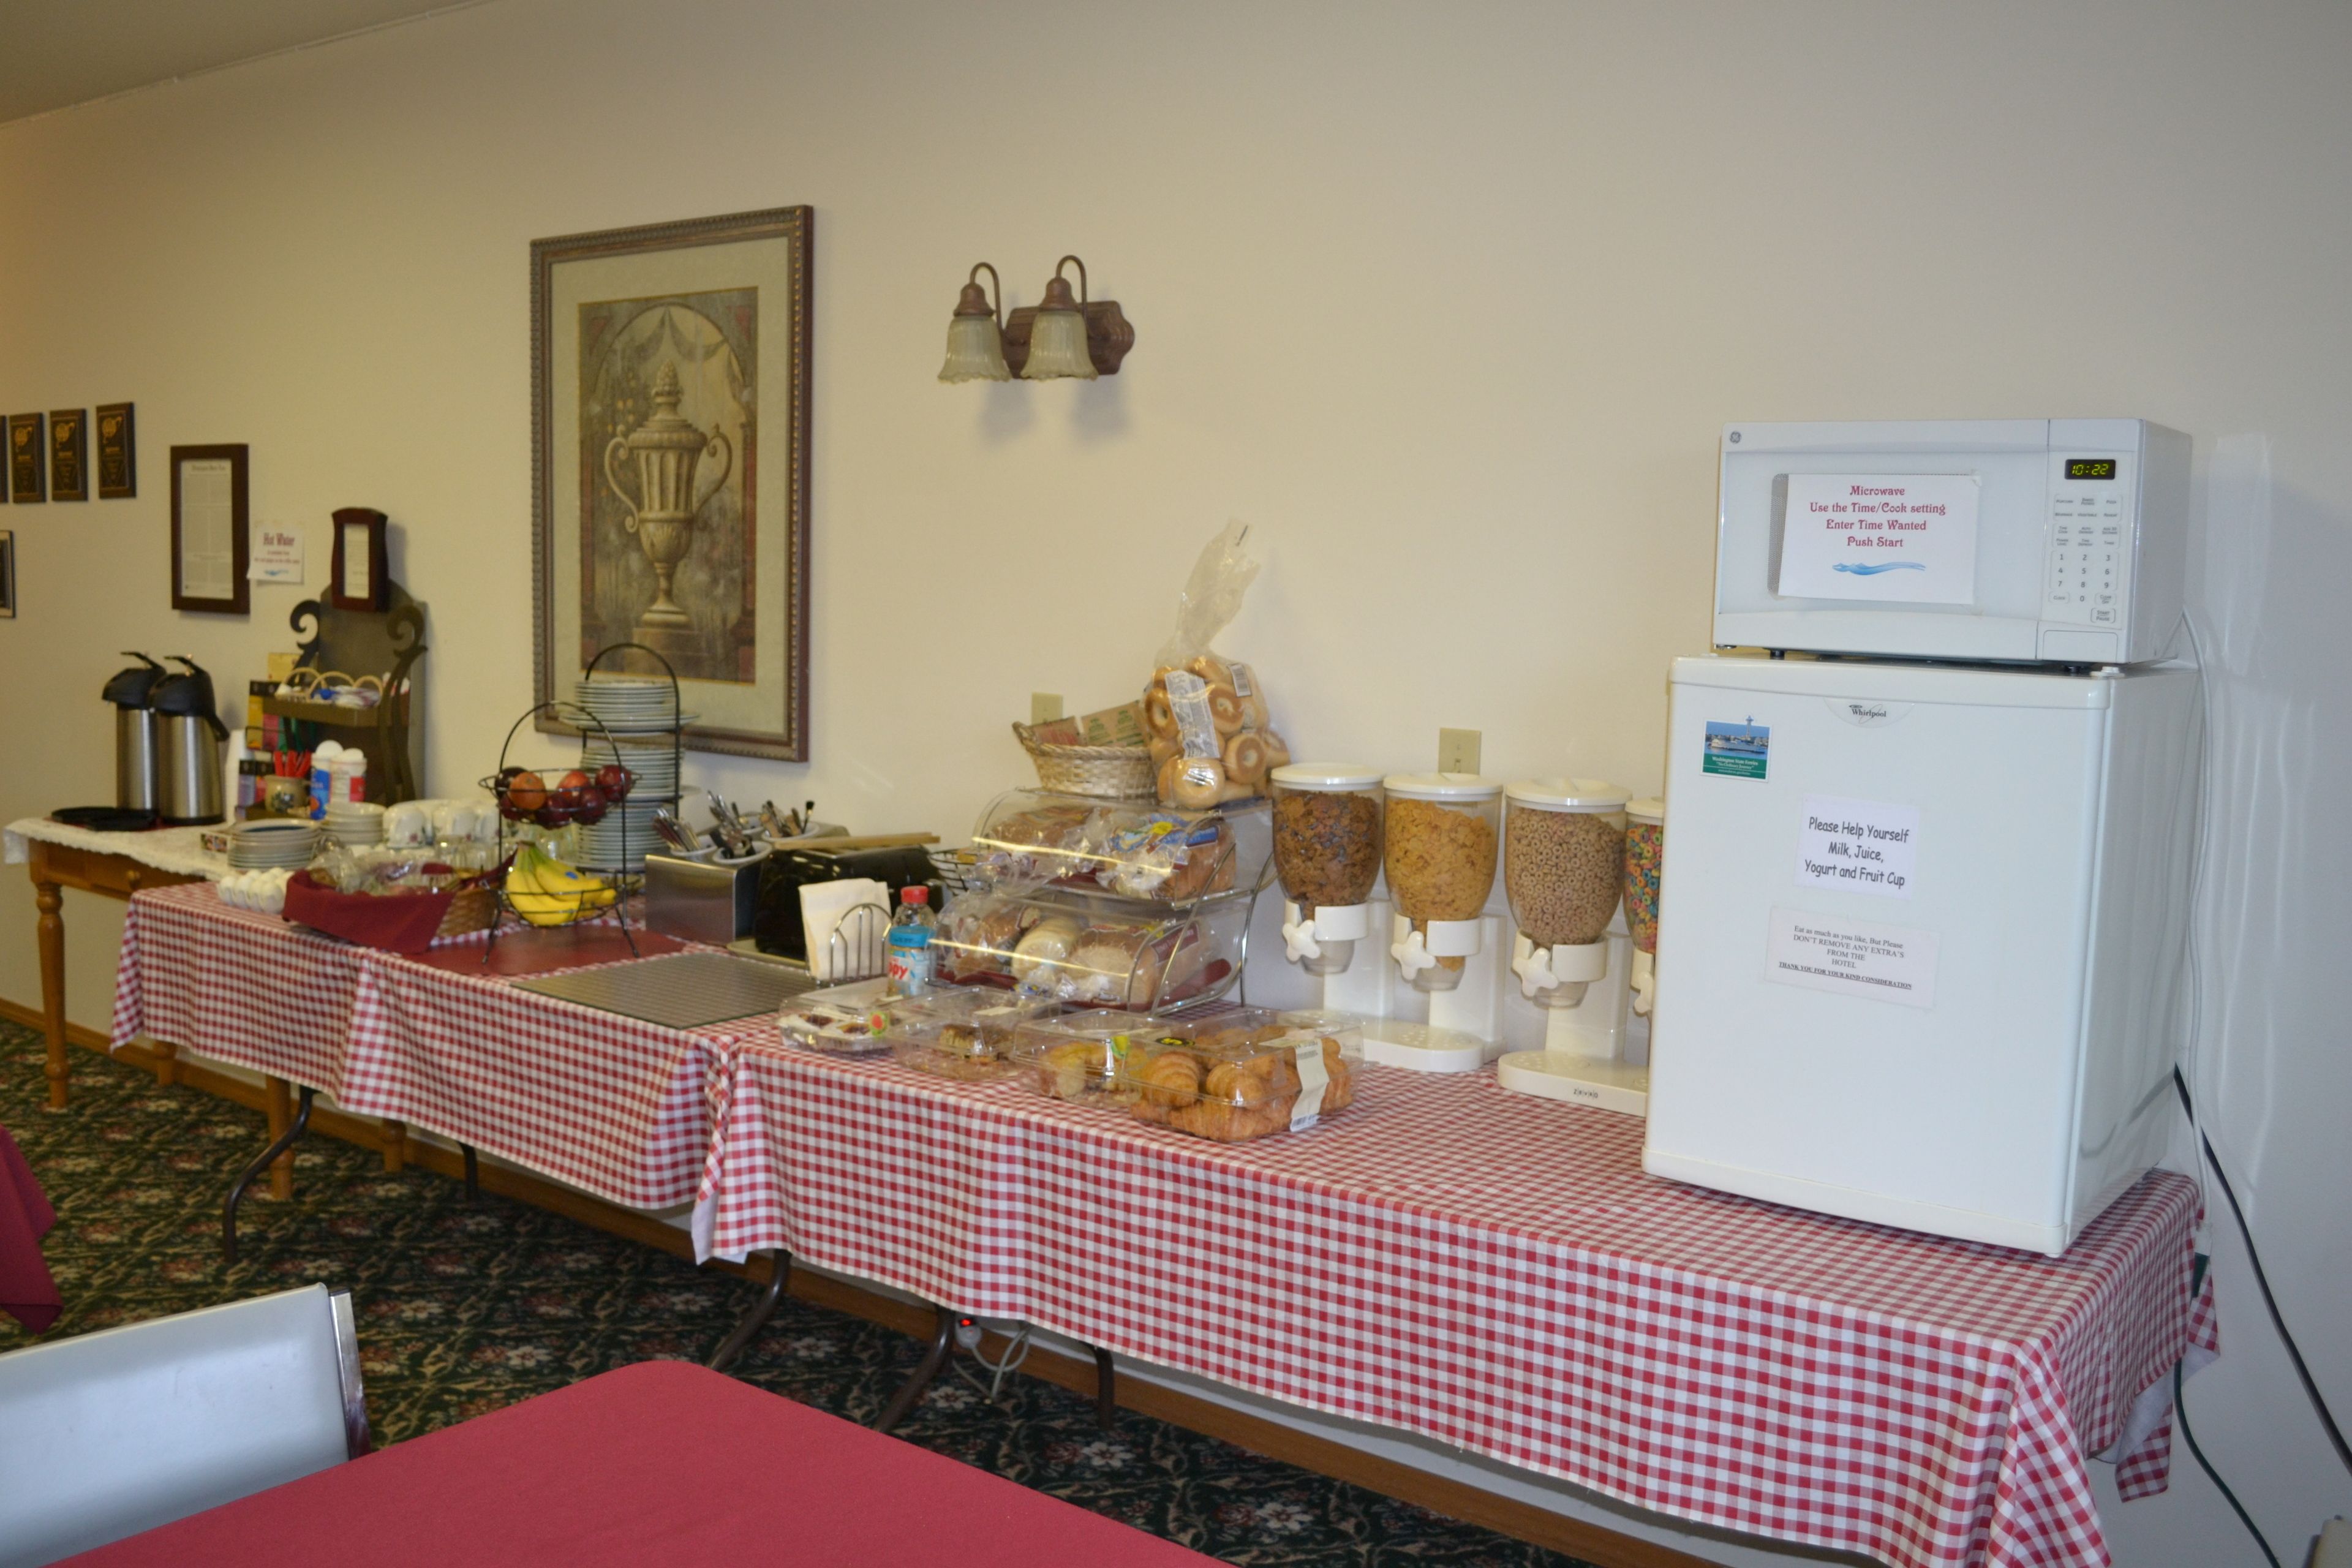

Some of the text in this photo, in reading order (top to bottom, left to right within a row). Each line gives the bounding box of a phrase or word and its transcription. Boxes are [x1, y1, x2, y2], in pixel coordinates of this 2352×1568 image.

[2071, 464, 2109, 475] 10:22
[1850, 485, 1905, 496] Microwave
[1810, 502, 1946, 516] Use the Time/Cook setting
[1826, 519, 1927, 530] Enter Time Wanted
[1847, 536, 1904, 547] Push Start
[1852, 709, 1887, 718] Whirlpool
[1809, 816, 1910, 843] Please Help Yourself
[1828, 841, 1884, 863] Milk, Juice,
[1804, 859, 1905, 889] Yogurt and Fruit Cup
[1814, 929, 1831, 938] much
[1841, 933, 1853, 942] you
[1854, 935, 1868, 944] like,
[1869, 937, 1881, 946] But
[1883, 939, 1904, 949] Please
[1818, 938, 1851, 950] REMOVE
[1852, 944, 1869, 953] ANY
[1871, 947, 1904, 959] EXTRA'S
[1826, 949, 1866, 961] FROM THE
[1831, 959, 1856, 969] HOTEL
[1779, 961, 1912, 990] THANK YOU FOR YOUR KIND CONSIDERATION
